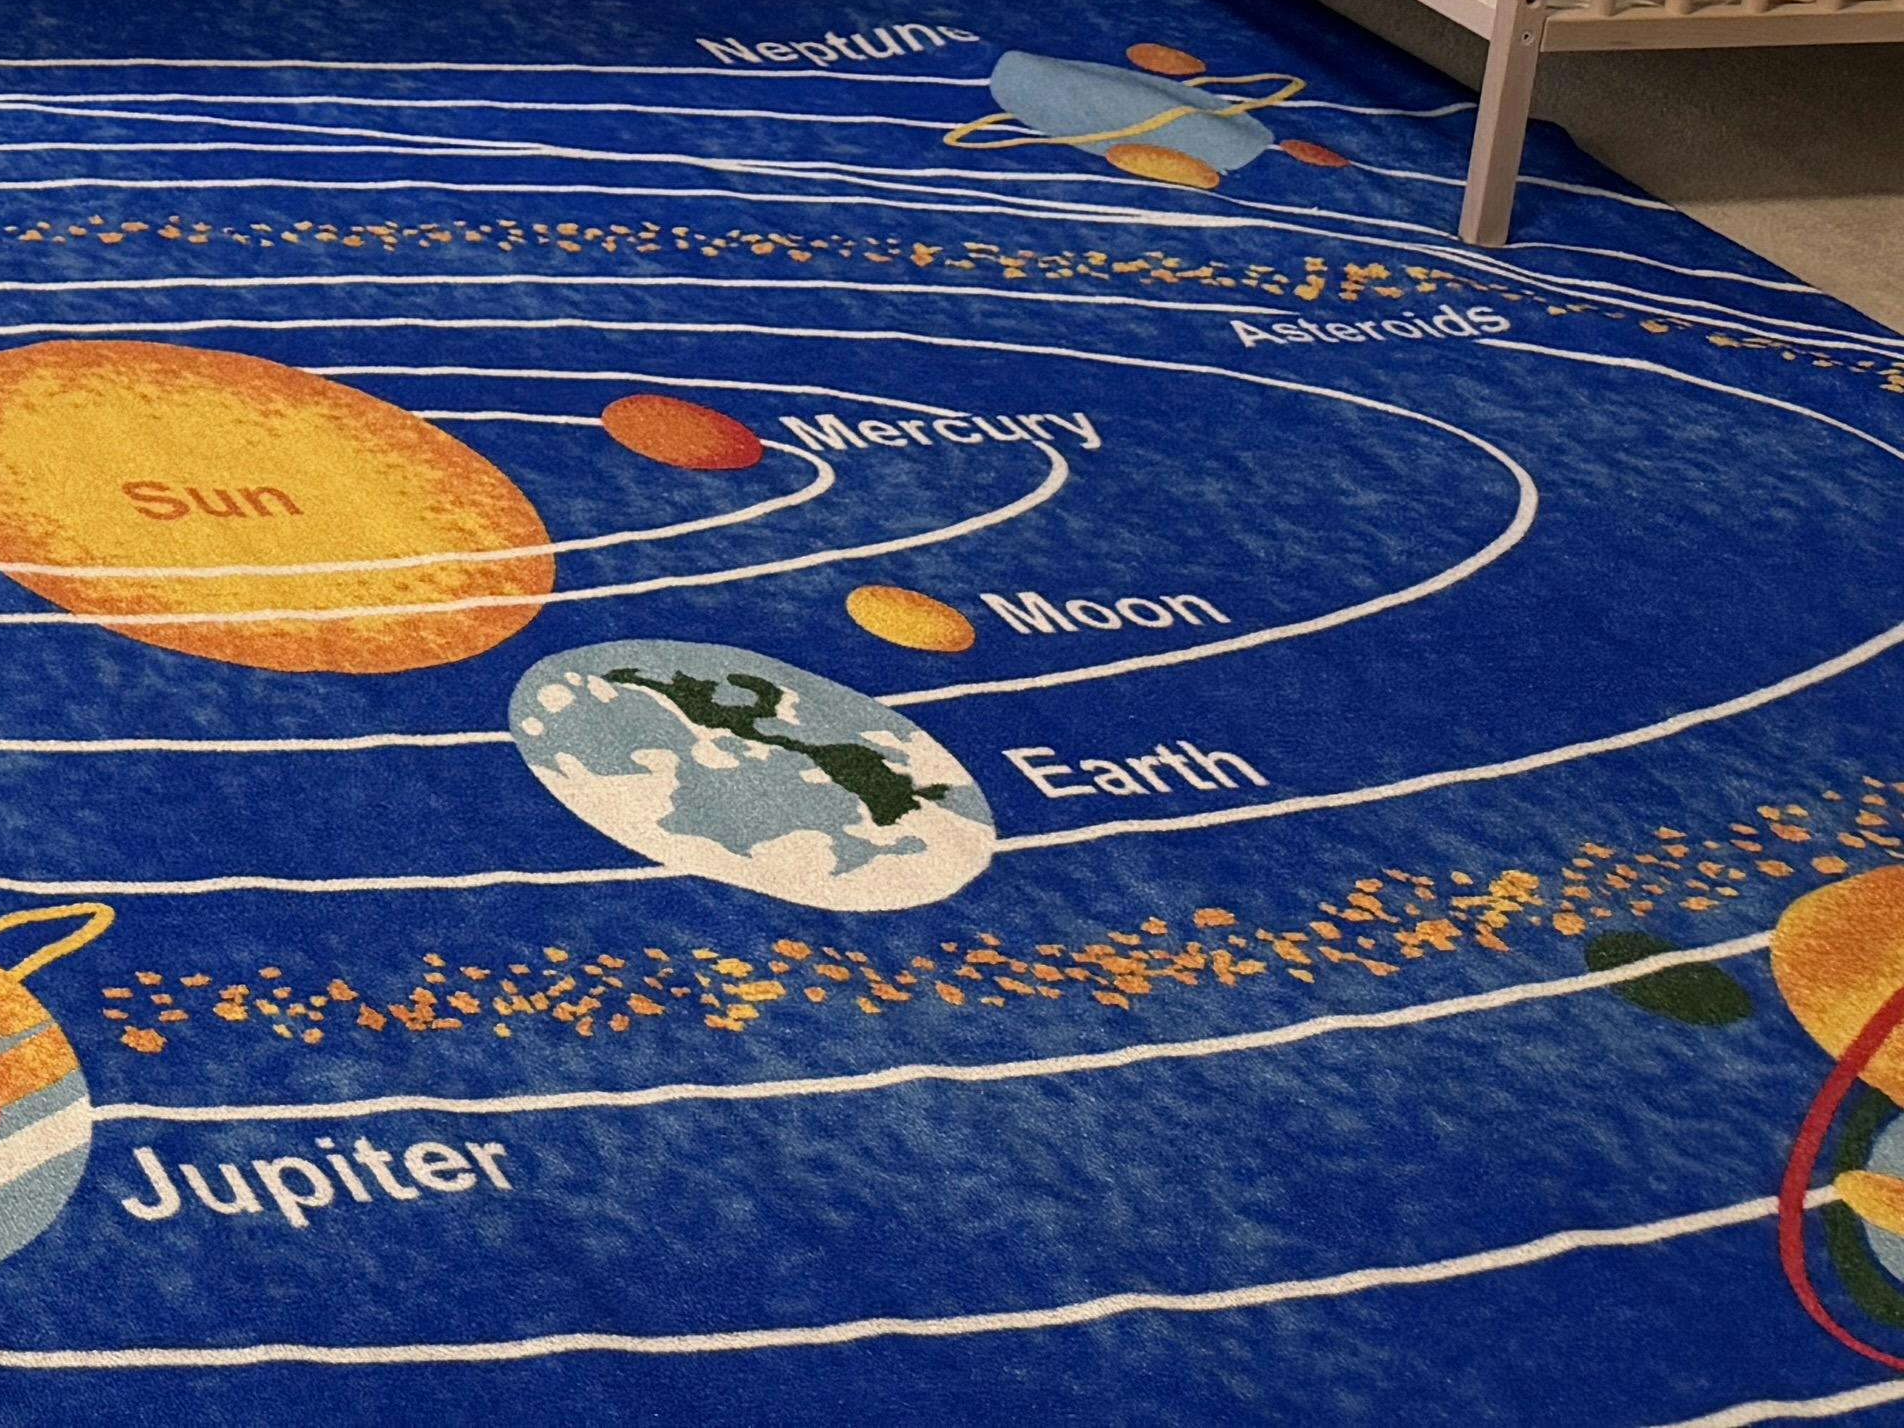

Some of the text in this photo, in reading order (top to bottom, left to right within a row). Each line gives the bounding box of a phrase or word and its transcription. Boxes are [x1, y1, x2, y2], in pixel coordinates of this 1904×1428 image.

[1227, 301, 1513, 349] Asteroids
[782, 405, 1103, 456] Mercury
[120, 480, 305, 522] Sun
[978, 590, 1232, 635] Moon
[1000, 739, 1272, 800] Earth
[120, 1135, 514, 1230] Jupiter
